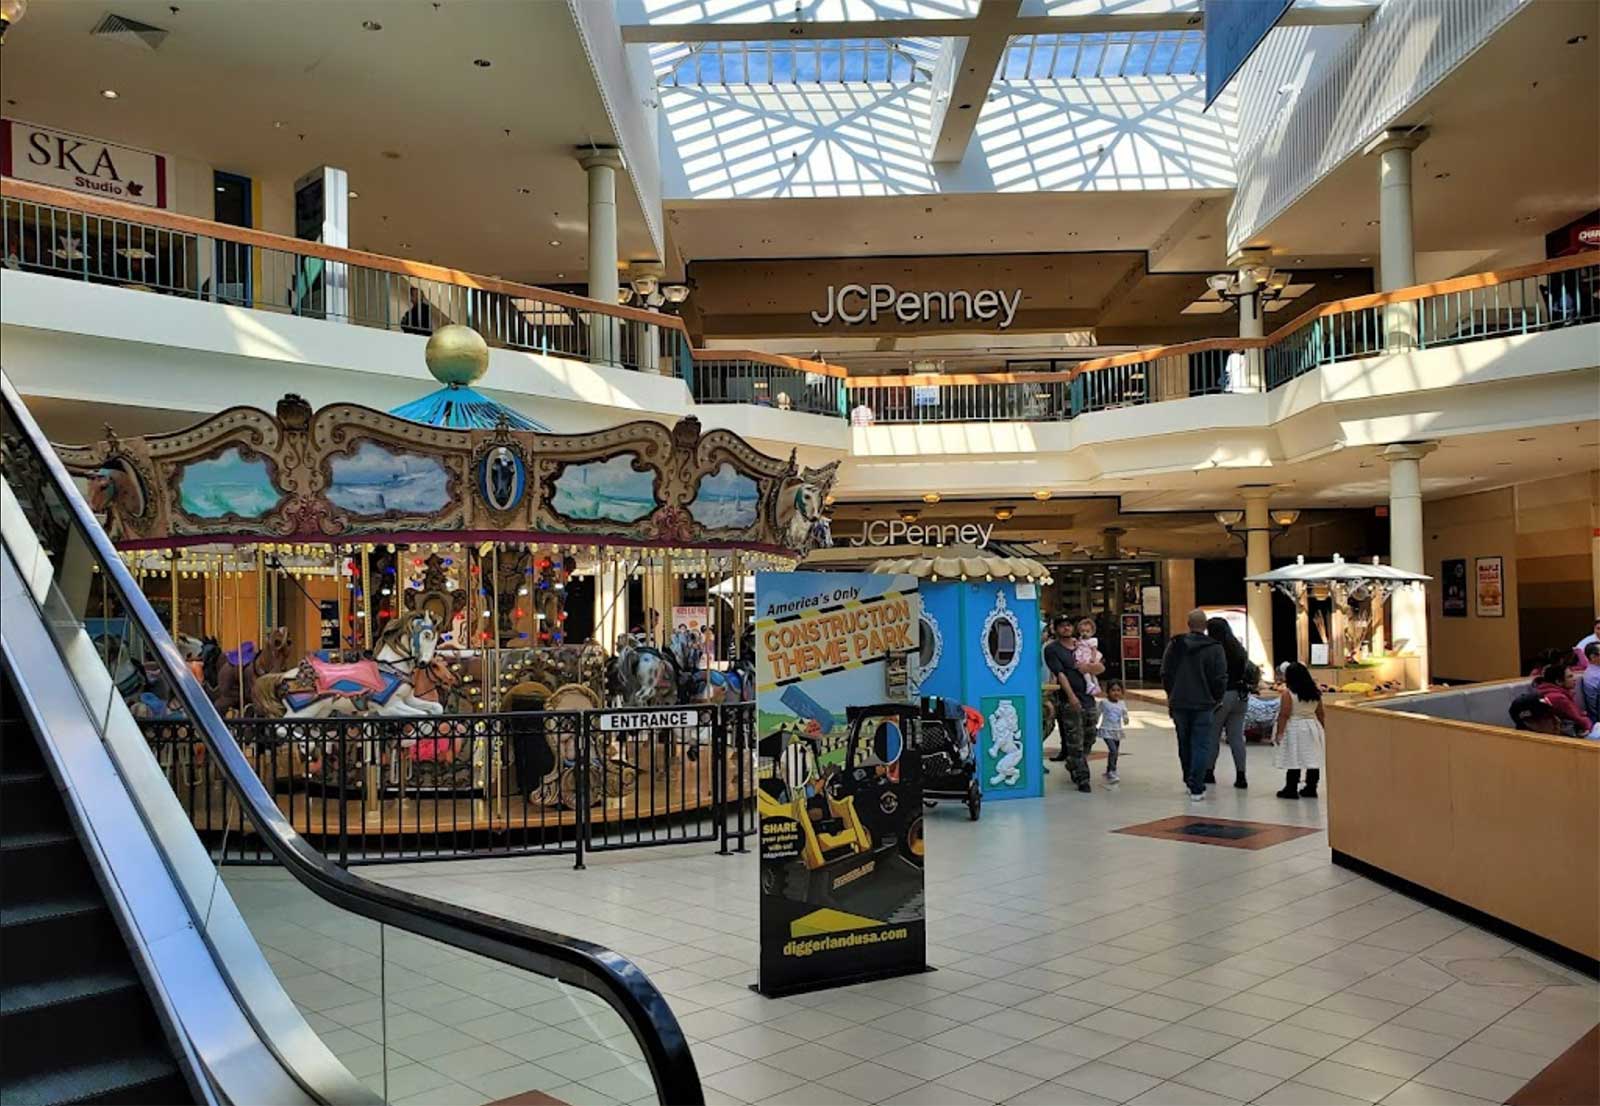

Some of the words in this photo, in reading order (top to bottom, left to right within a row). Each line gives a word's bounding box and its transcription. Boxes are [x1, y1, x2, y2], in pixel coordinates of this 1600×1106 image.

[28, 132, 122, 182] SKA
[74, 176, 122, 195] Studio
[811, 284, 1022, 328] JCPenney
[850, 520, 994, 549] JCPenney
[767, 592, 830, 616] America's
[833, 587, 861, 602] Only
[764, 599, 911, 651] CONSTRUCTION
[767, 637, 849, 680] THEME
[852, 622, 914, 659] PARK
[611, 712, 688, 729] ENTRANCE
[763, 822, 797, 834] SHARE
[783, 928, 908, 956] diggerlandusa.com
